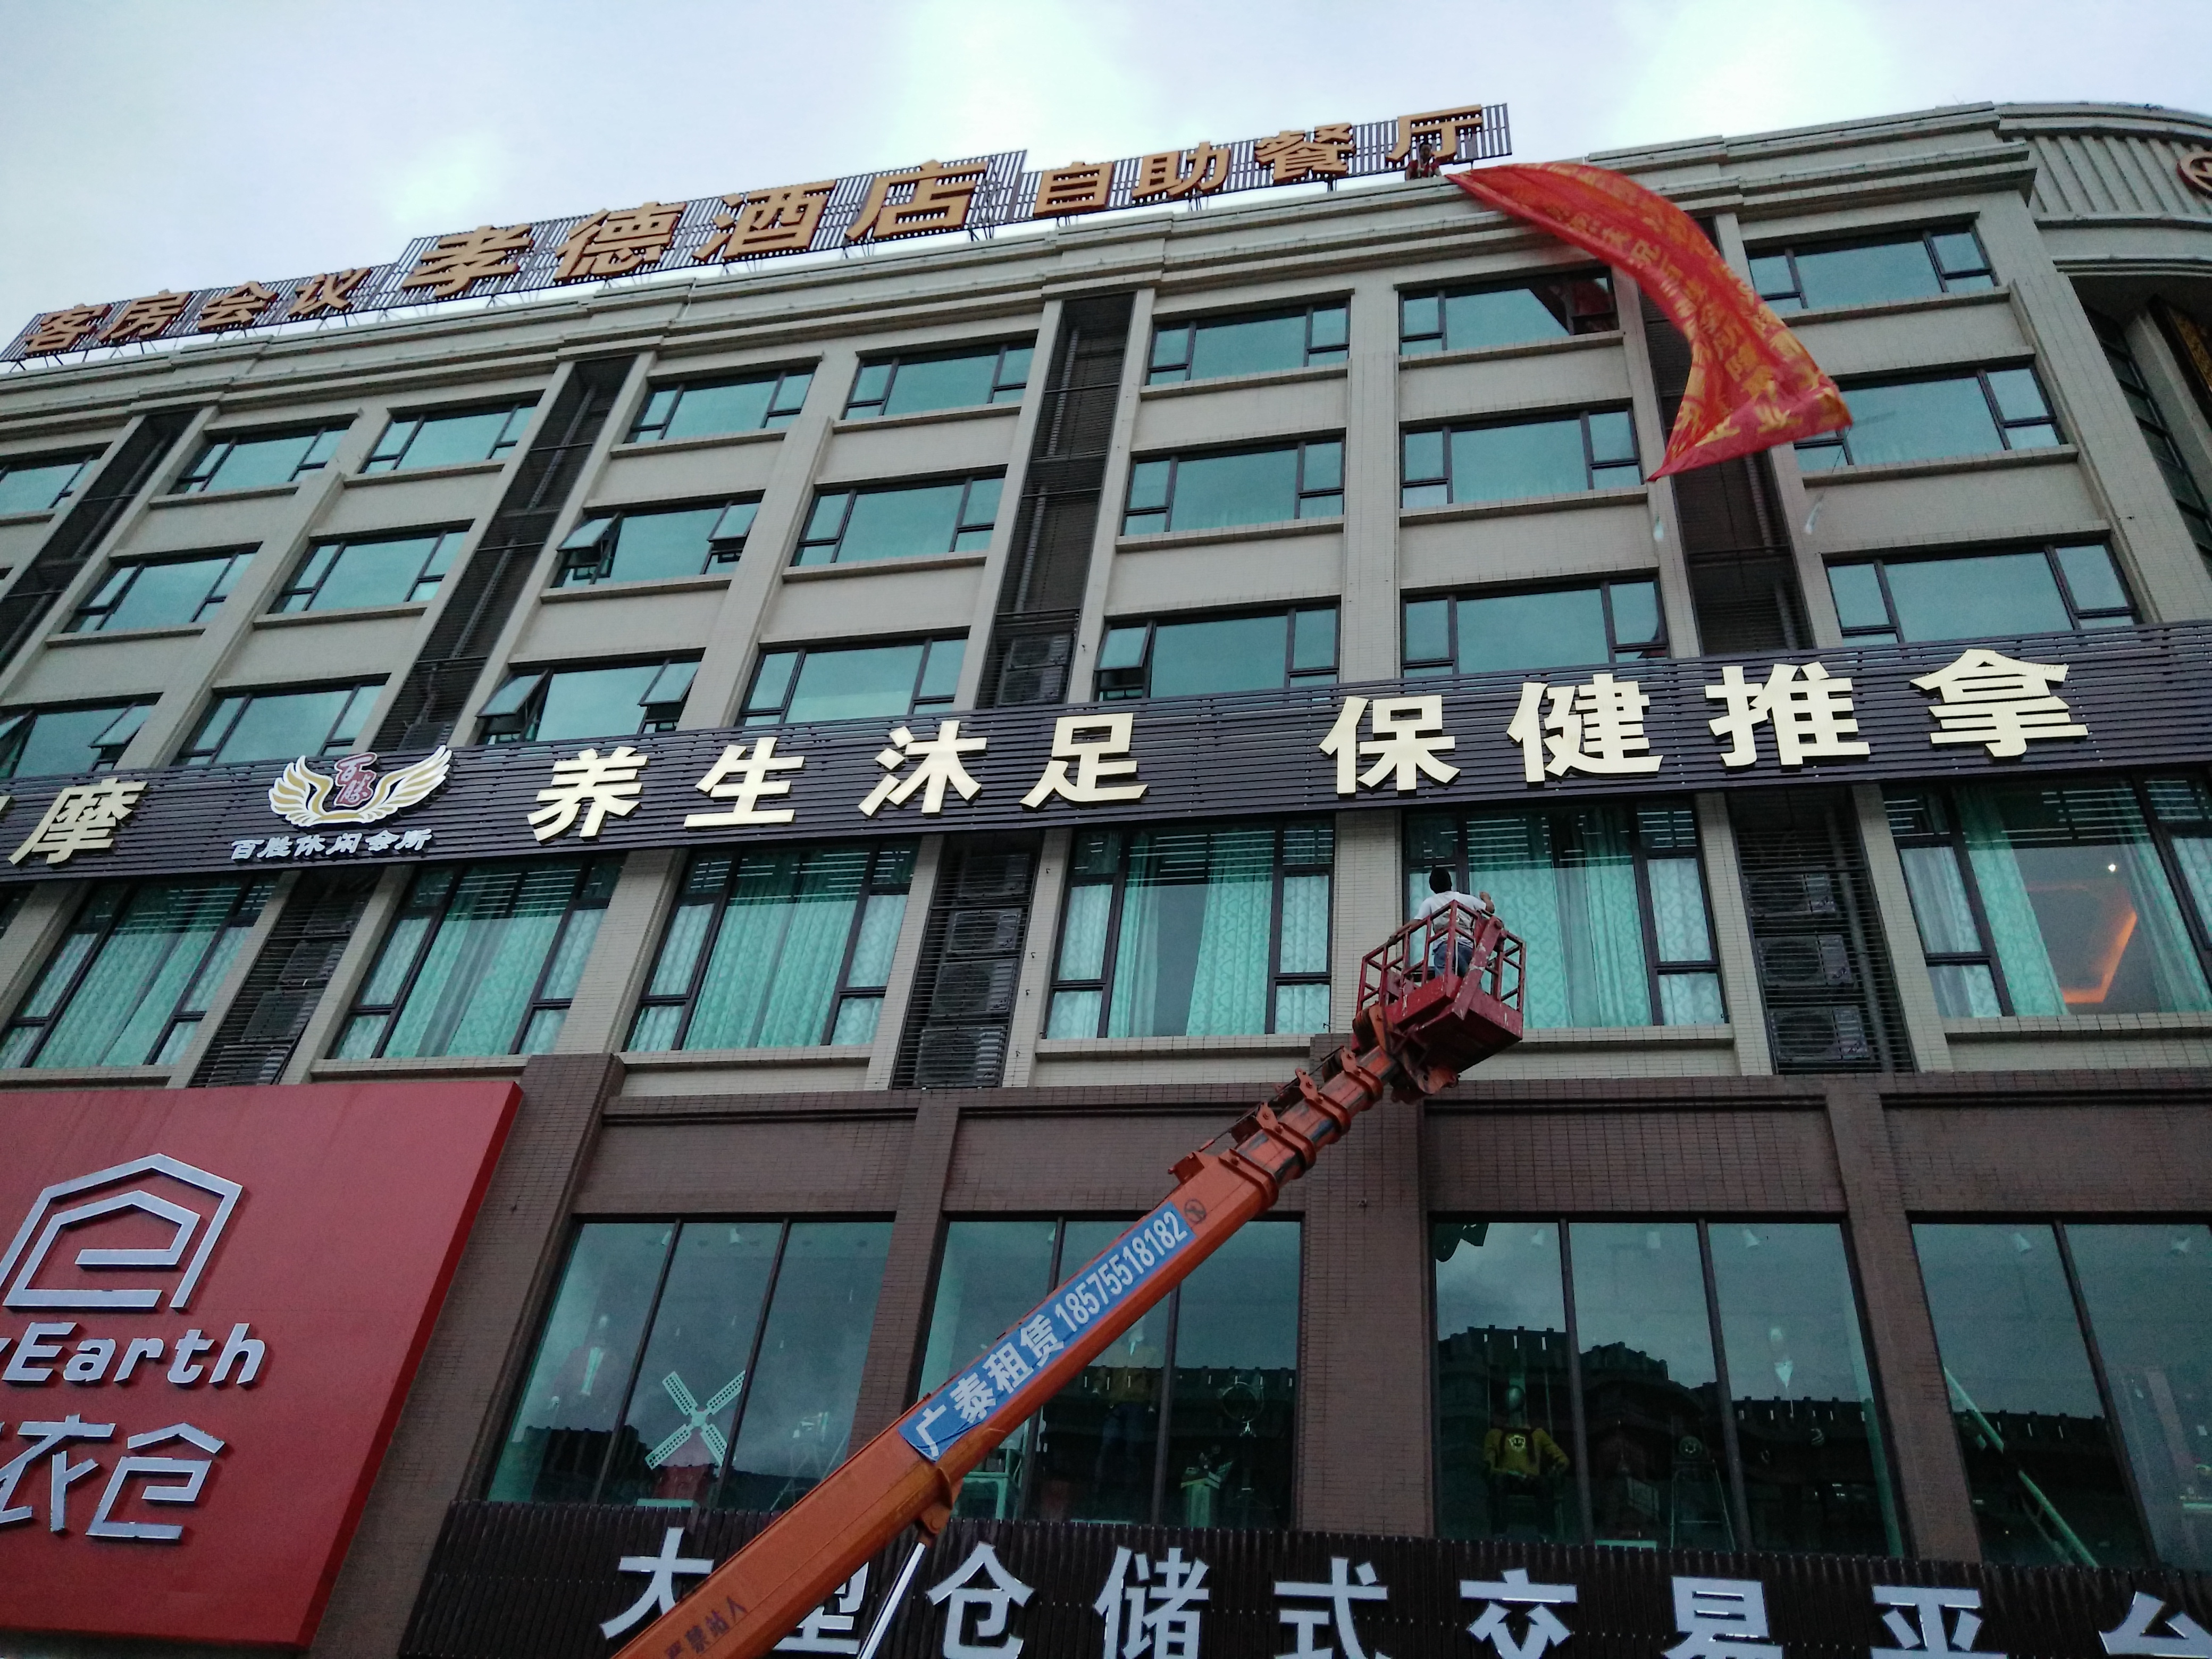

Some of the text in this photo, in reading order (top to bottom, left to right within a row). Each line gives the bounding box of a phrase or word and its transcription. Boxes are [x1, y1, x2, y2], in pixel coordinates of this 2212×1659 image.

[24, 267, 371, 356] 客房会议
[1033, 104, 1483, 216] 自助餐厅
[0, 648, 2089, 865] 摩 养生沐足 保健推拿
[231, 828, 432, 860] 百胜休闲会所
[0, 1322, 266, 1385] Earth
[915, 1211, 1188, 1457] 广泰租赁 18575518182
[0, 1413, 225, 1538] 衣仓
